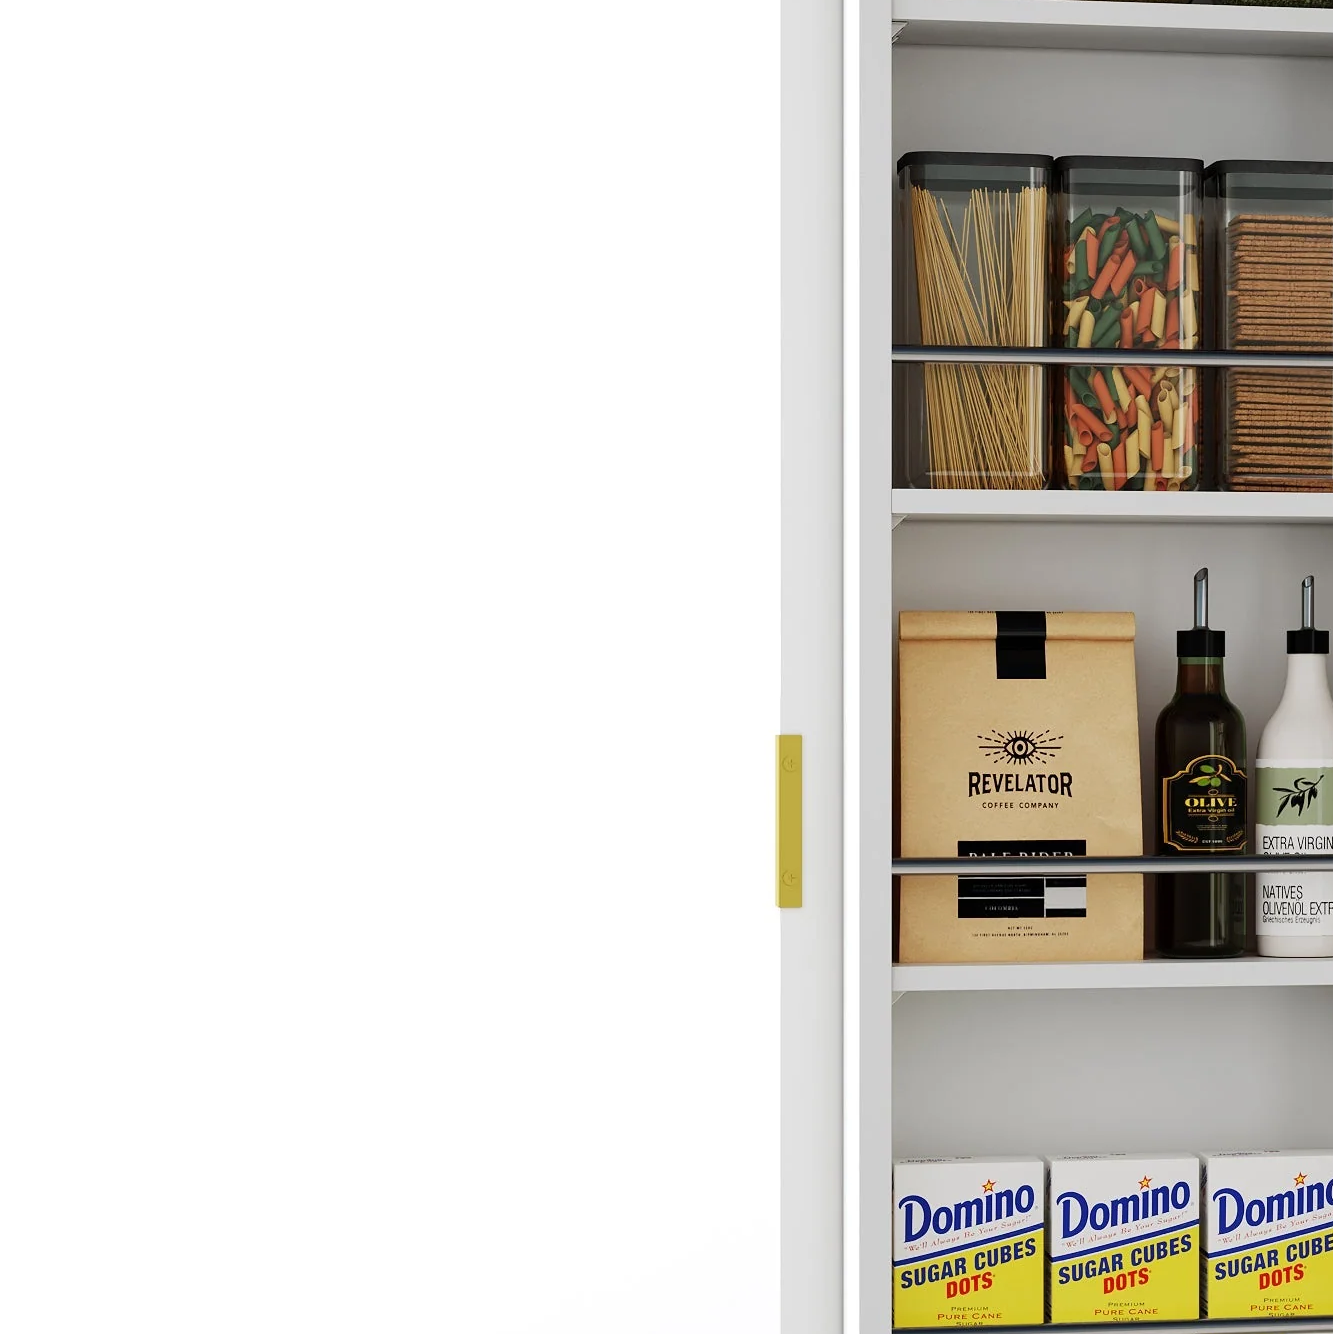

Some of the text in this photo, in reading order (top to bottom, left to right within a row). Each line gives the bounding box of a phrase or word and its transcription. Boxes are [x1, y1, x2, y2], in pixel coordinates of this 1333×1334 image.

[968, 772, 1072, 797] REVELATOR
[1185, 798, 1237, 807] OLIVE
[1262, 836, 1333, 849] EXTRA VIRGIN
[1262, 885, 1303, 899] NATIVES
[1262, 898, 1307, 915] OLIVENÖL
[1295, 916, 1321, 924] Erzeugnis
[899, 1185, 1034, 1243] Domino
[1056, 1181, 1190, 1239] Domino
[901, 1238, 1036, 1289] SUGAR CUBES
[1059, 1234, 1192, 1284] SUGAR CUBES
[1215, 1249, 1278, 1281] SUGAR
[947, 1272, 993, 1298] DOTS
[1104, 1268, 1149, 1294] DOTS
[1260, 1263, 1304, 1290] DOTS
